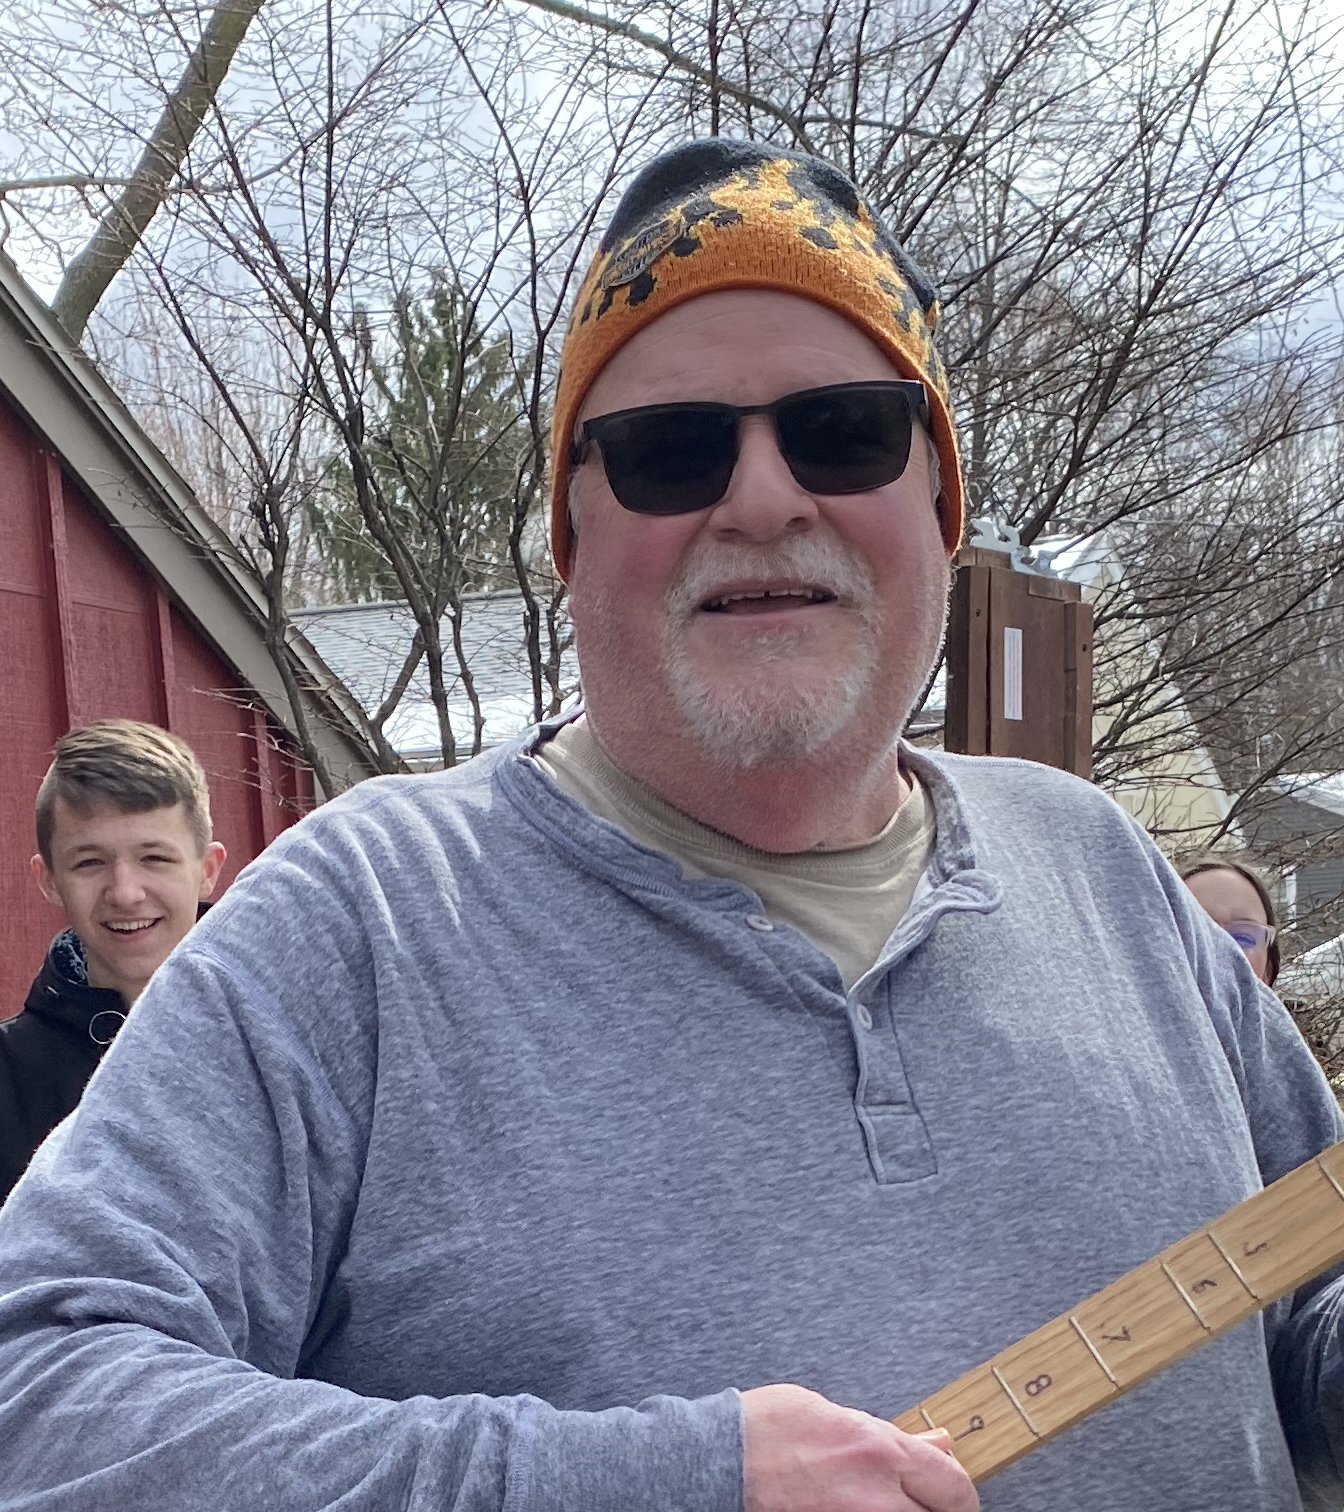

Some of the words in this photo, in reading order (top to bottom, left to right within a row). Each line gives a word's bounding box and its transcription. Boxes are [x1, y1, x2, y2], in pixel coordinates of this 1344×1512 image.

[1191, 1279, 1218, 1295] 6
[1102, 1325, 1131, 1342] 7
[1024, 1374, 1053, 1397] 8
[954, 1414, 985, 1442] 9
